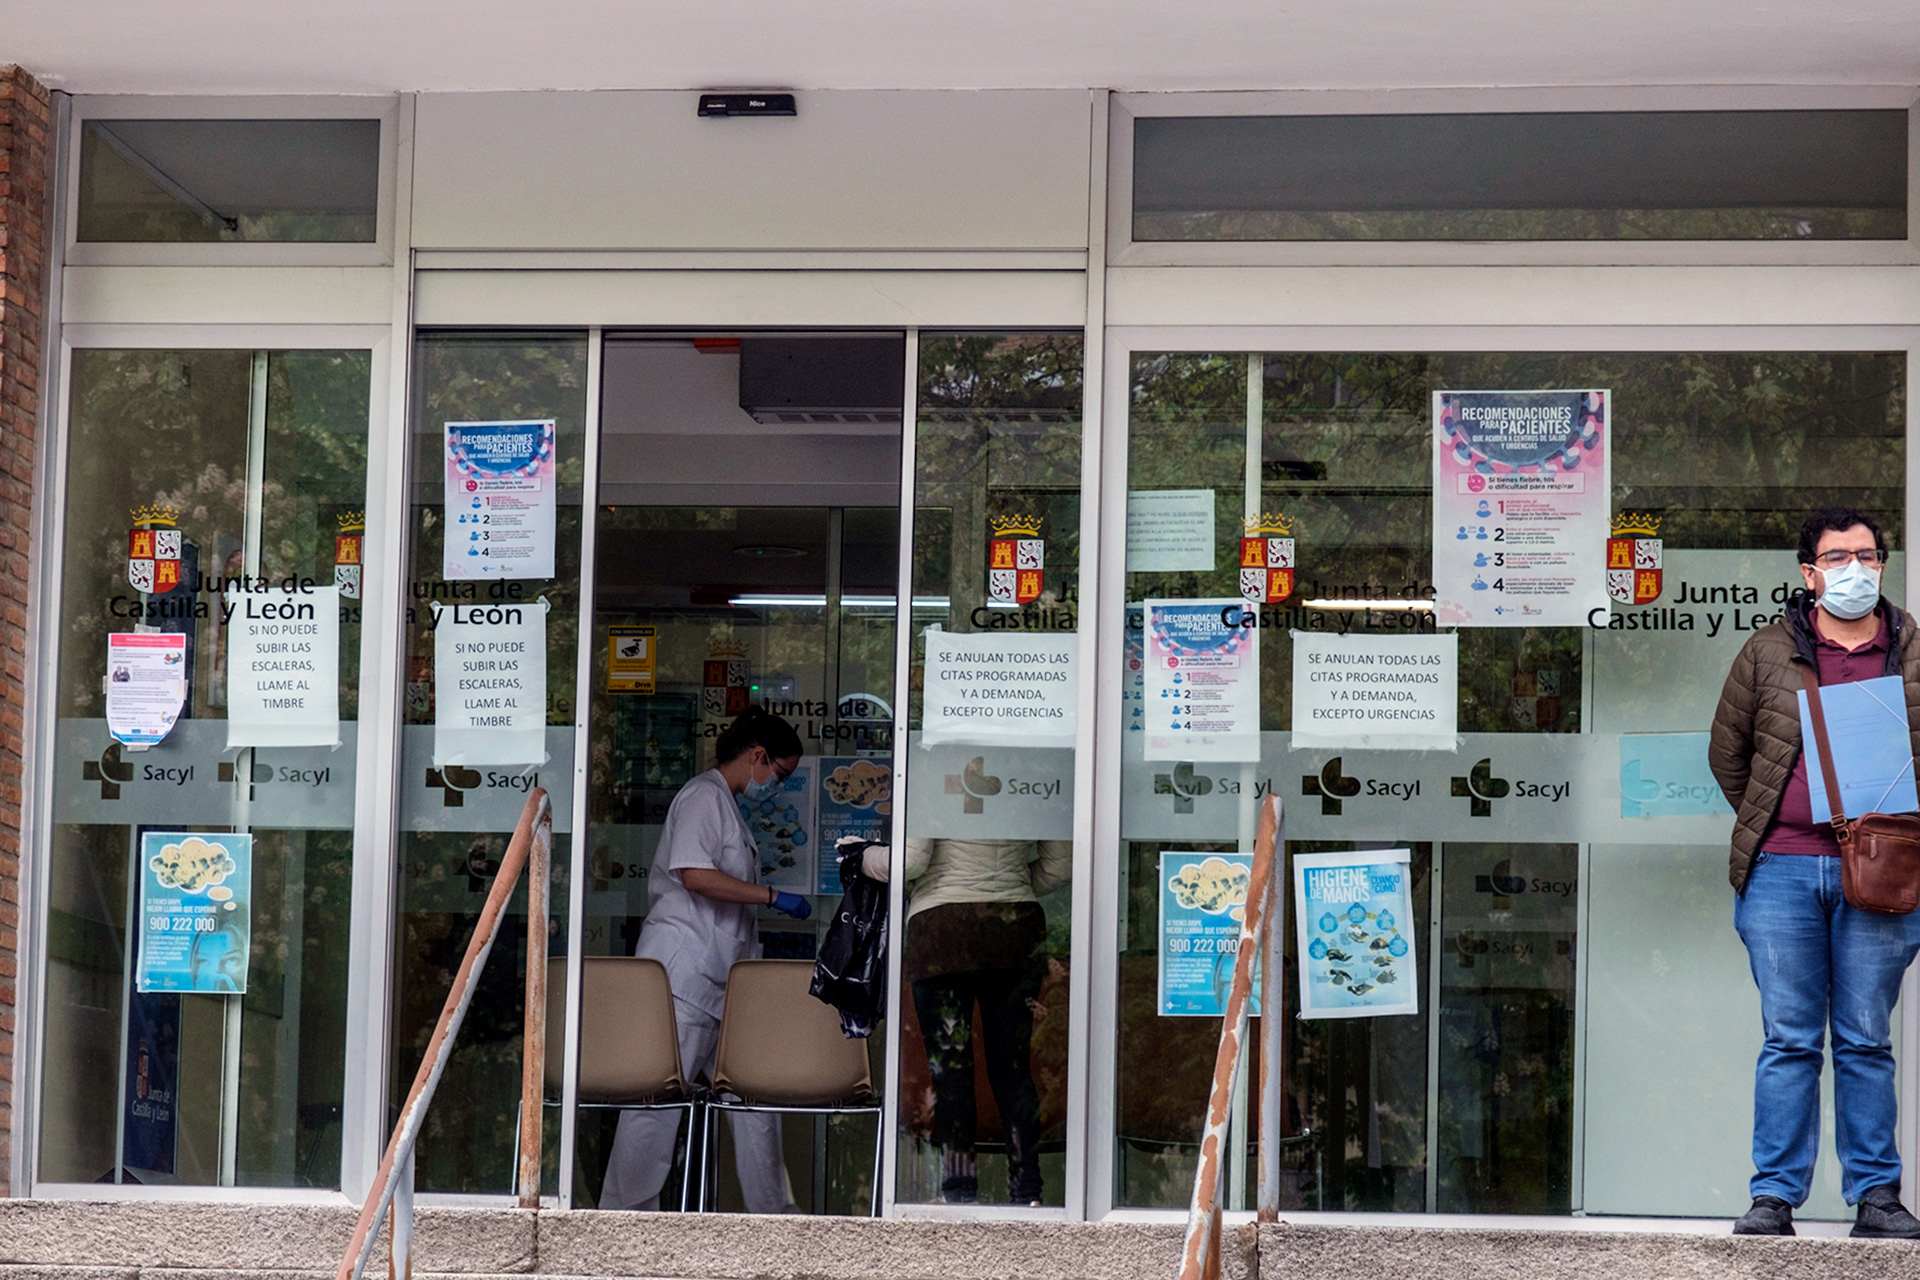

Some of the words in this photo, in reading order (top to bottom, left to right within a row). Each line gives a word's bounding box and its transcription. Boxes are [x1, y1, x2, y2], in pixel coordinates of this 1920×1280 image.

[1462, 407, 1571, 420] RECOMENDACIONES
[1480, 421, 1499, 429] PARA
[1500, 420, 1571, 434] PACIENTES
[462, 434, 533, 444] RECOMENDACIONES
[487, 443, 532, 453] PACIENTES
[485, 497, 490, 506] 1
[1498, 500, 1504, 514] 1
[483, 515, 490, 524] 2
[483, 531, 490, 540] 3
[1494, 528, 1504, 541] 2
[482, 547, 489, 556] 4
[1494, 553, 1504, 566] 3
[190, 571, 269, 594] Junta
[281, 573, 315, 594] de
[488, 578, 523, 599] de
[1493, 578, 1504, 591] 4
[1305, 581, 1388, 602] Junta
[1402, 581, 1437, 602] de
[1673, 582, 1758, 604] Junta
[109, 596, 209, 619] Castilla
[220, 601, 236, 625] y
[246, 597, 315, 620] León
[427, 607, 444, 631] y
[453, 603, 522, 625] León
[971, 607, 1074, 629] Castilla
[1221, 606, 1325, 628] Castilla
[1338, 611, 1355, 636] y
[1365, 607, 1437, 629] León
[1587, 607, 1695, 631] Castilla
[1706, 615, 1723, 637] y
[248, 625, 259, 635] SI
[261, 625, 280, 635] NO
[282, 624, 318, 635] PUEDE
[255, 643, 289, 653] SUBIR
[291, 642, 311, 653] LAS
[455, 643, 466, 654] SI
[468, 643, 485, 653] NO
[489, 642, 525, 652] PUEDE
[939, 652, 952, 663] SE
[955, 652, 1004, 663] ANULAN
[1006, 653, 1047, 664] TODAS
[1049, 653, 1069, 664] LAS
[1308, 653, 1322, 664] SE
[1325, 654, 1374, 665] ANULAN
[1377, 654, 1418, 665] TODAS
[1420, 654, 1441, 665] LAS
[251, 660, 316, 673] ESCALERAS,
[463, 661, 496, 672] SUBIR
[499, 661, 518, 670] LAS
[940, 670, 973, 681] CITAS
[976, 671, 1067, 682] PROGRAMADAS
[1186, 673, 1190, 681] 1
[1310, 672, 1343, 683] CITAS
[1346, 672, 1439, 684] PROGRAMADAS
[256, 680, 292, 691] LLAME
[296, 680, 310, 691] AL
[459, 679, 523, 690] ESCALERAS,
[960, 689, 969, 699] Y
[970, 689, 979, 699] A
[982, 689, 1046, 702] DEMANDA,
[1184, 690, 1191, 699] 2
[1331, 690, 1340, 701] Y
[1340, 690, 1350, 701] A
[1352, 690, 1418, 703] DEMANDA,
[262, 698, 304, 709] TIMBRE
[464, 699, 501, 709] LLAME
[504, 698, 518, 708] AL
[838, 698, 868, 717] de
[1184, 705, 1191, 714] 3
[943, 706, 994, 717] EXCEPTO
[996, 707, 1063, 718] URGENCIAS
[1312, 708, 1365, 719] EXCEPTO
[1367, 709, 1435, 720] URGENCIAS
[470, 716, 512, 727] TIMBRE
[1184, 721, 1191, 730] 4
[808, 720, 868, 740] León
[143, 764, 194, 786] Sacyl
[278, 766, 330, 787] Sacyl
[487, 771, 538, 792] Sacyl
[1007, 778, 1061, 799] Sacyl
[1366, 779, 1420, 801] Sacyl
[1514, 780, 1570, 802] Sacyl
[1666, 782, 1720, 804] Sacyl
[824, 829, 842, 841] 900
[864, 829, 881, 840] 000
[1309, 868, 1369, 888] HIGIENE
[1311, 888, 1322, 899] DE
[1323, 886, 1370, 904] MANOS
[150, 917, 170, 930] 900
[172, 917, 192, 931] 222
[194, 918, 215, 931] 000
[1169, 939, 1191, 953] 900
[1193, 939, 1214, 953] 222
[1217, 939, 1238, 953] 000
